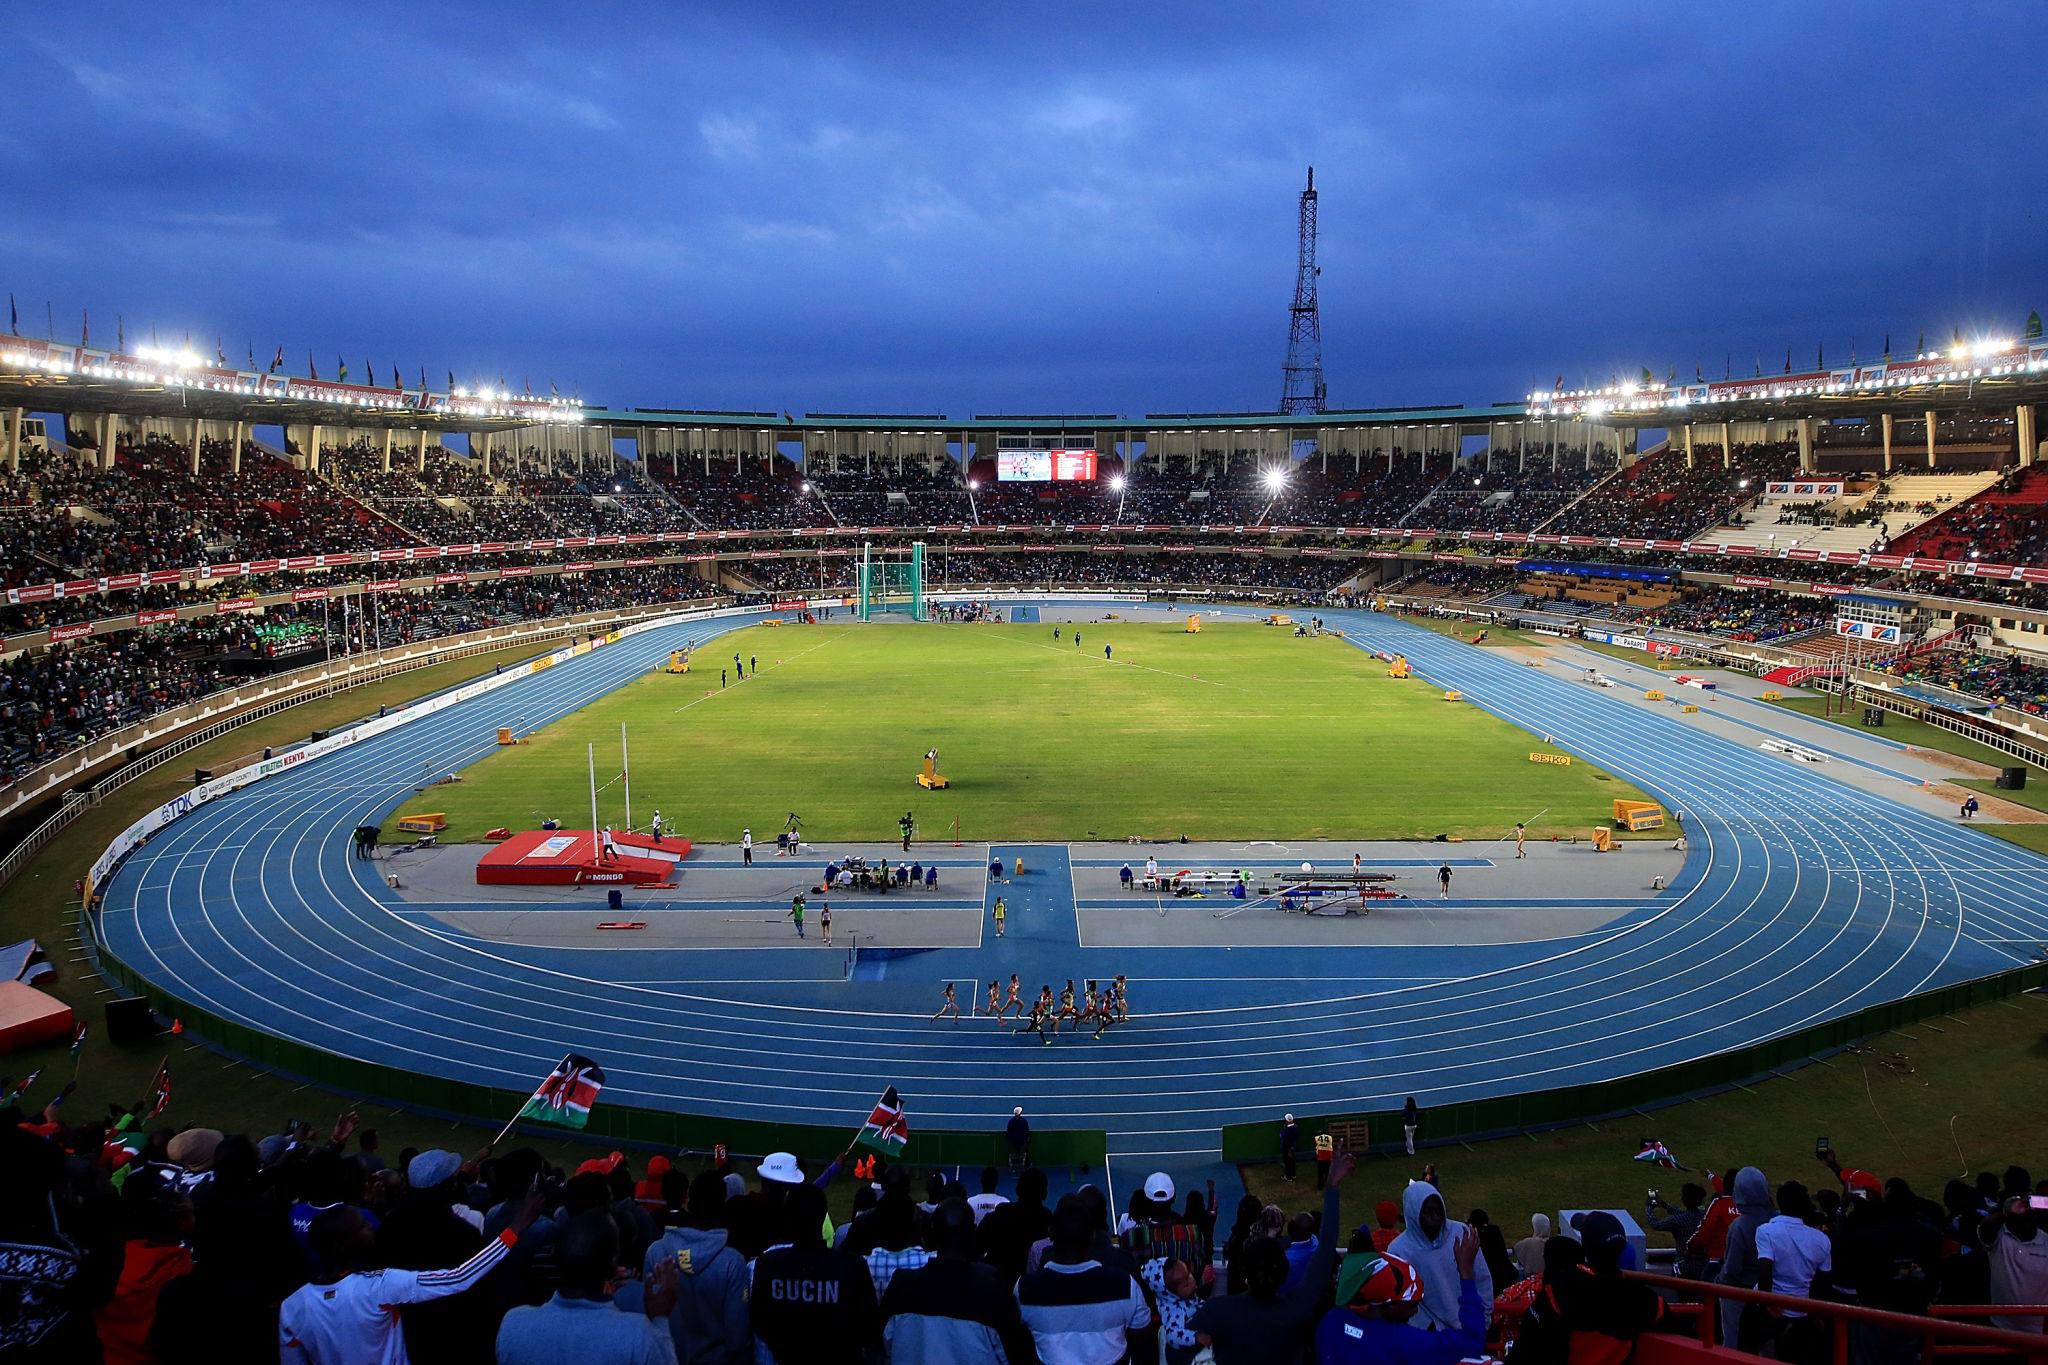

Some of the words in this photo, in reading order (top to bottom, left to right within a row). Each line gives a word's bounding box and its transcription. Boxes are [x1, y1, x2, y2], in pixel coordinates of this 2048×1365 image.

[284, 751, 305, 766] KENYA
[1532, 753, 1568, 765] SEIKO
[168, 792, 194, 818] TDK
[592, 873, 624, 881] MONDO
[771, 1278, 839, 1304] GUCIN
